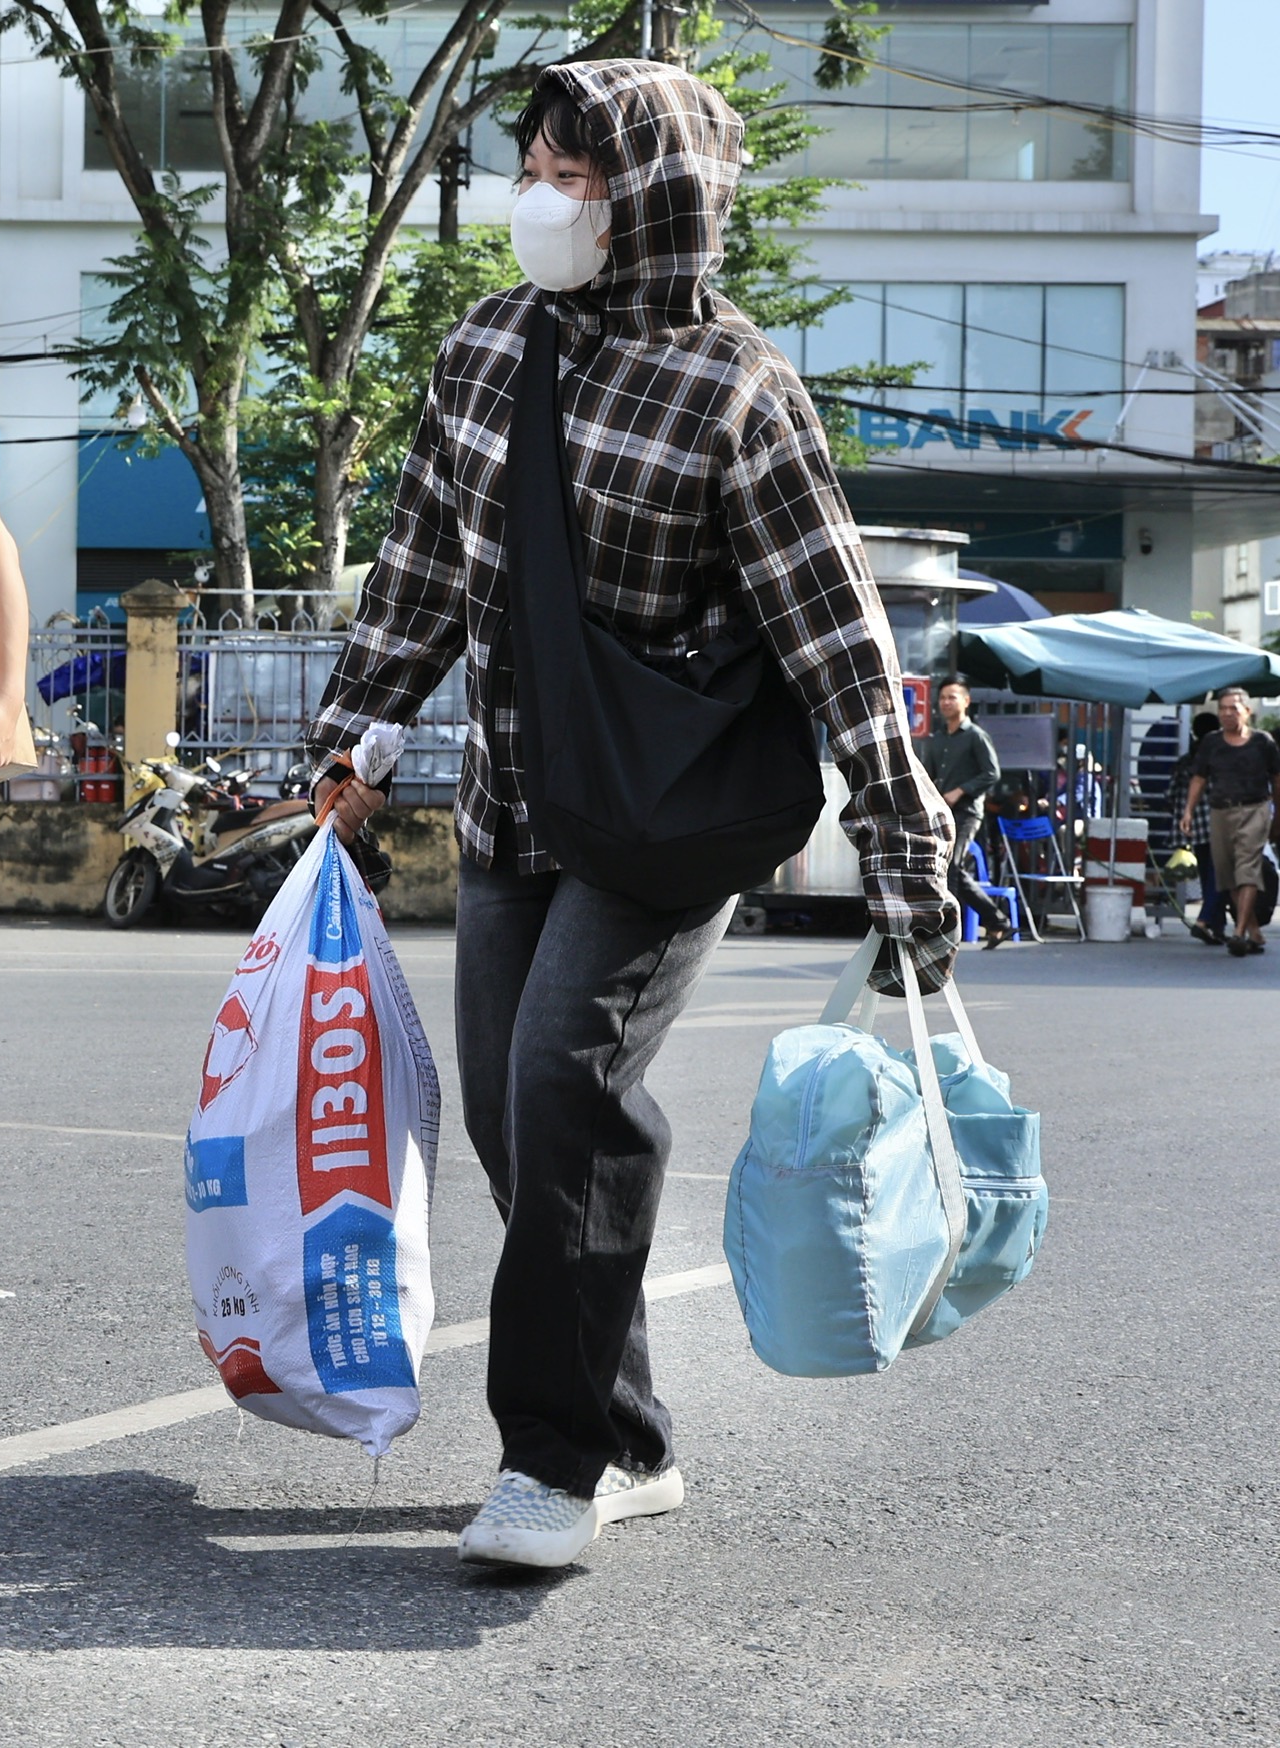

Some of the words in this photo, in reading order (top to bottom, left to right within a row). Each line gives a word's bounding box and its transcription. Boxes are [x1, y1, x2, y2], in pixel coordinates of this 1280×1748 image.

[824, 407, 1076, 450] BANK
[310, 986, 370, 1172] 1130S
[206, 1178, 222, 1197] KG
[320, 1253, 339, 1279] HỢP
[367, 1259, 381, 1276] KG
[317, 1283, 338, 1309] HỖN
[343, 1274, 361, 1304] SIÊU
[368, 1280, 382, 1298] 30
[221, 1297, 231, 1317] 25
[323, 1312, 340, 1331] ĂN
[347, 1308, 366, 1334] LỢN
[372, 1314, 386, 1328] 12
[325, 1334, 348, 1369] THỨC
[351, 1338, 370, 1364] CHO
[369, 1331, 389, 1347] TỪ
